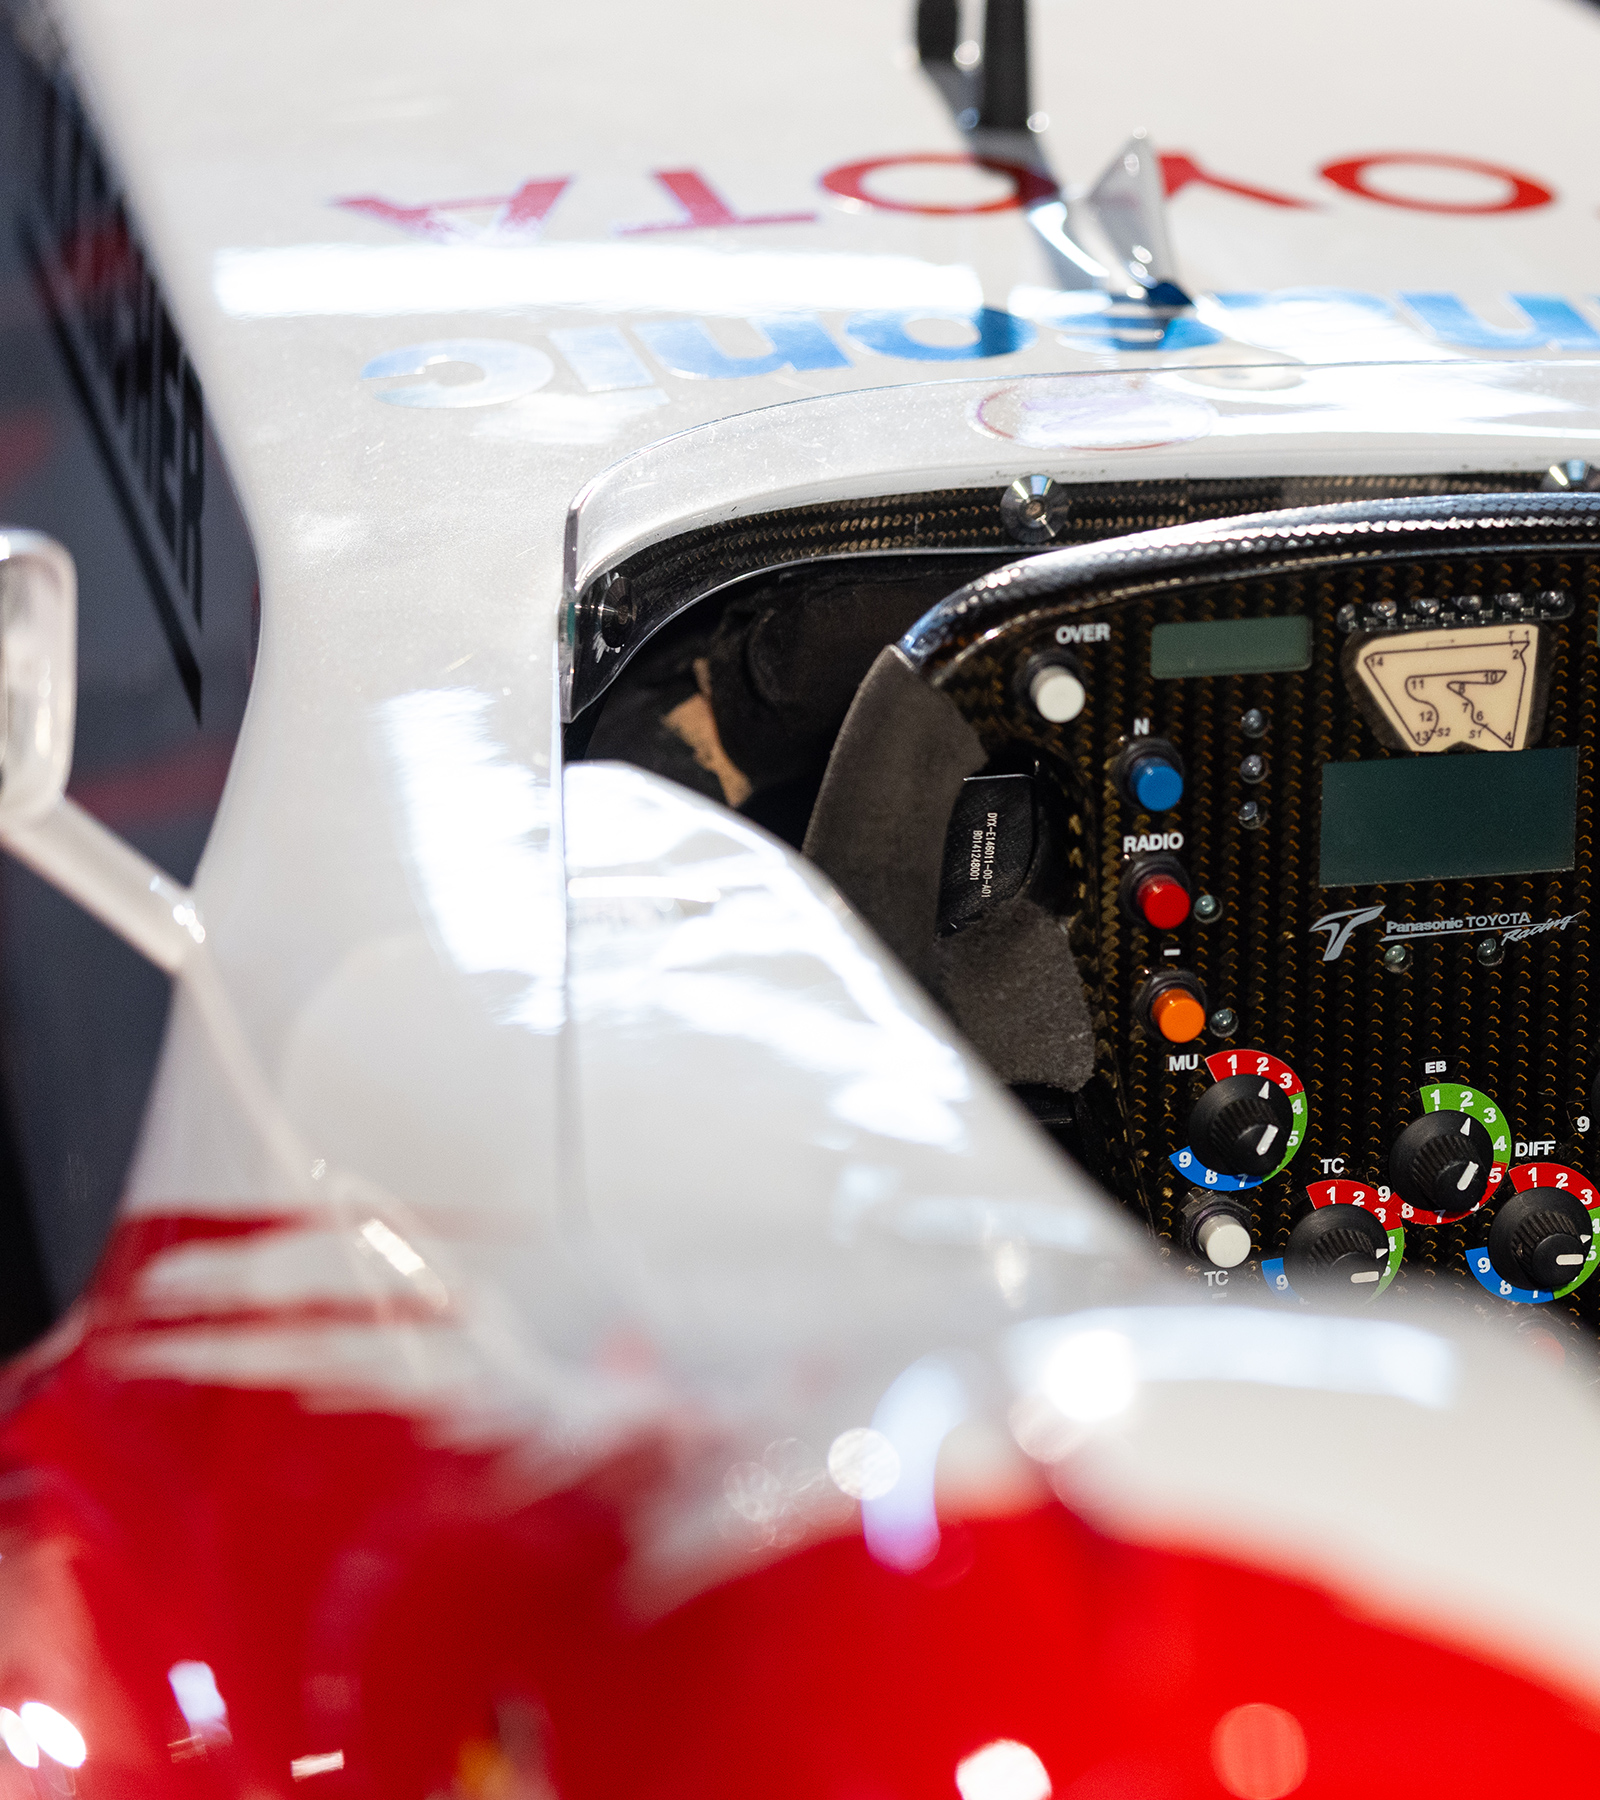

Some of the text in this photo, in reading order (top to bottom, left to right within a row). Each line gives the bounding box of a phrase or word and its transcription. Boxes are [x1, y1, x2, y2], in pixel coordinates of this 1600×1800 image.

[1055, 622, 1111, 645] OVER
[1370, 656, 1384, 667] 14
[1512, 649, 1519, 660] 2
[1411, 679, 1424, 689] 11
[1484, 671, 1498, 683] 10
[1462, 702, 1469, 713] 7
[1476, 710, 1484, 721] 6
[1420, 711, 1433, 722] 12
[1133, 717, 1150, 736] N
[1436, 727, 1451, 738] S2
[1416, 732, 1429, 742] 13
[1504, 731, 1512, 742] 4
[1123, 832, 1184, 853] RADIO
[1386, 911, 1531, 935] Panasonic TOYOTA
[1501, 910, 1586, 947] Racing
[1168, 1054, 1199, 1072] MU
[1425, 1061, 1447, 1074] EB
[1430, 1089, 1441, 1105] 1
[1460, 1091, 1474, 1108] 2
[1178, 1054, 1303, 1188] 1 2 3 4 5 7 8 9
[1483, 1107, 1497, 1124] 3
[1576, 1116, 1590, 1133] 9
[1493, 1135, 1507, 1152] 4
[1515, 1141, 1556, 1158] DIFF
[1320, 1157, 1345, 1174] TC
[1488, 1167, 1502, 1184] 5
[1527, 1167, 1538, 1182] 1
[1555, 1173, 1569, 1188] 2
[1326, 1186, 1336, 1202] 1
[1352, 1191, 1365, 1206] 2
[1377, 1185, 1391, 1203] 9
[1580, 1189, 1593, 1205] 3
[1374, 1207, 1386, 1224] 3
[1401, 1203, 1414, 1219] 8
[1477, 1257, 1491, 1274] 9
[1203, 1270, 1229, 1287] TC
[1275, 1274, 1289, 1291] 9
[1500, 1280, 1513, 1296] 8
